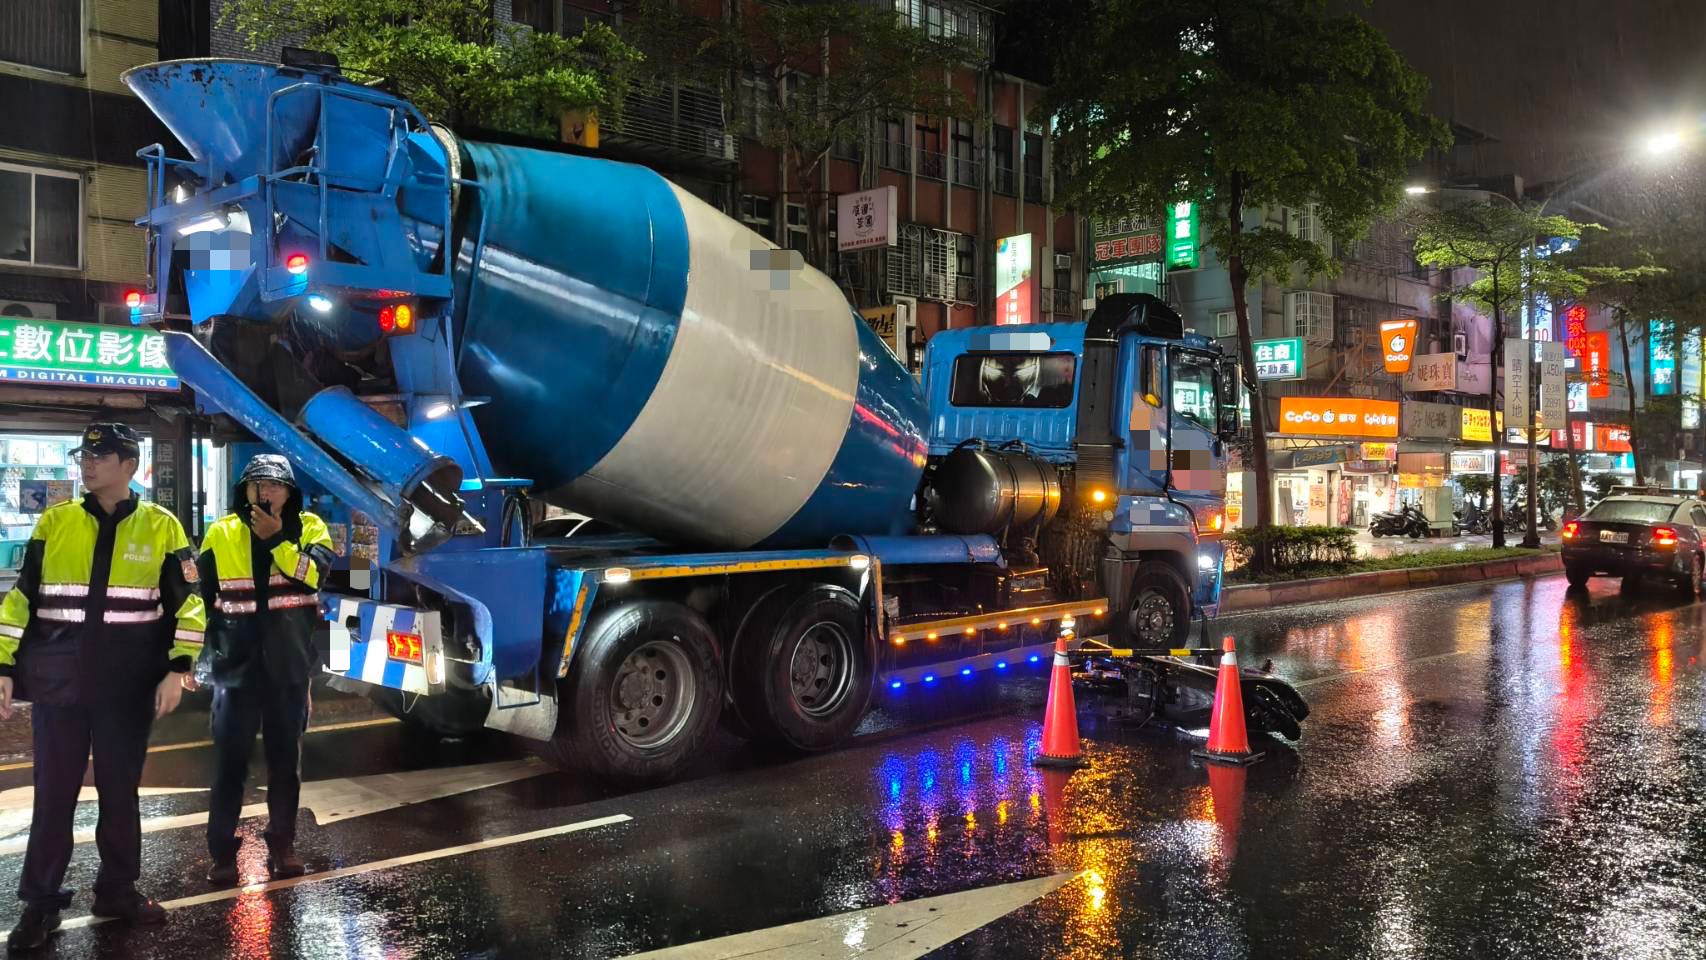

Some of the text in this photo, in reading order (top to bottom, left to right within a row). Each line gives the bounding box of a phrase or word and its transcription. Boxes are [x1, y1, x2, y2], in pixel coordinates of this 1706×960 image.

[1095, 234, 1162, 261] 冠軍團隊
[0, 324, 170, 369] 數位影像
[1255, 344, 1291, 361] 住商
[1386, 354, 1409, 362] CoCo
[1256, 363, 1290, 375] 不動產
[17, 370, 88, 383] DIGITAL
[95, 375, 169, 387] IMAGING
[1511, 358, 1523, 418] 晴空大地
[1285, 410, 1320, 423] CoCo
